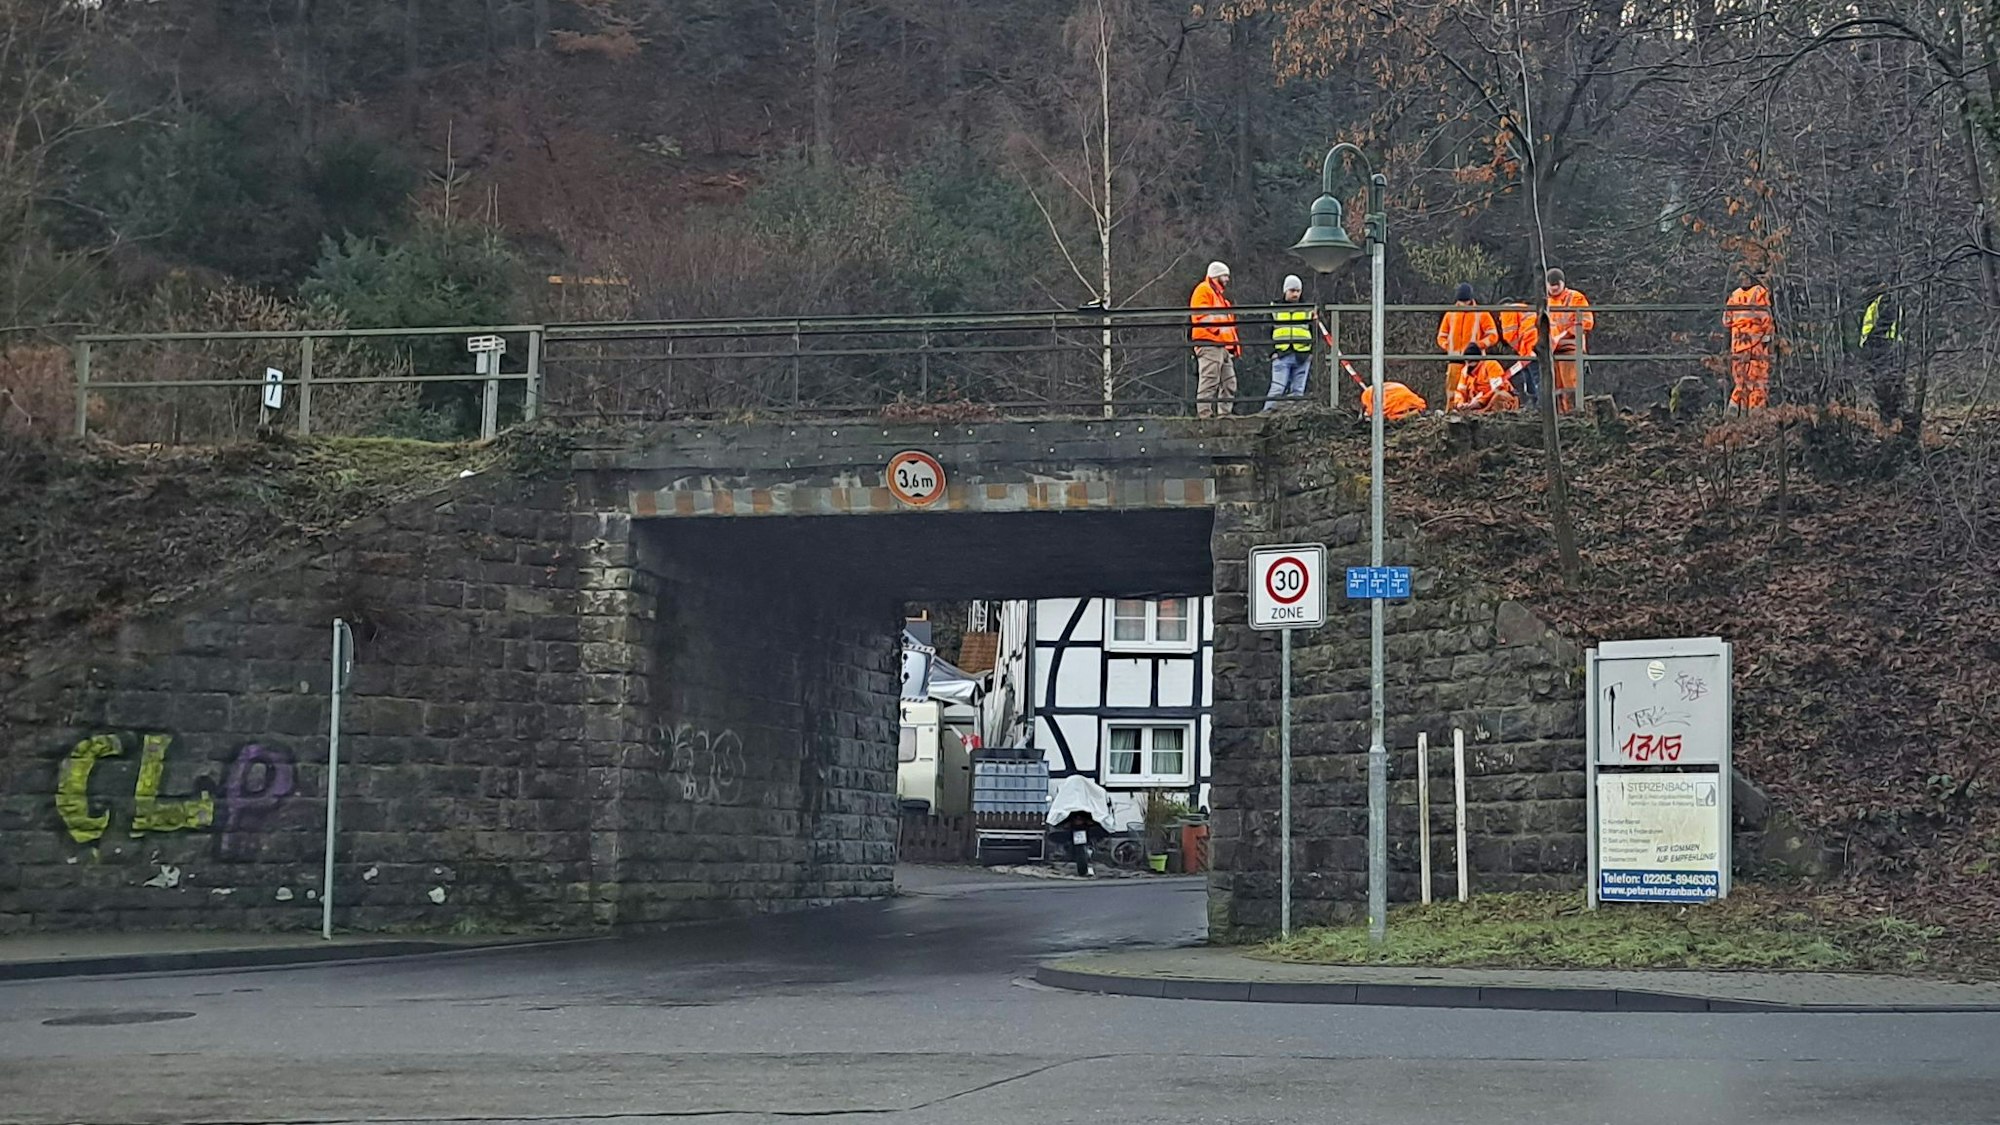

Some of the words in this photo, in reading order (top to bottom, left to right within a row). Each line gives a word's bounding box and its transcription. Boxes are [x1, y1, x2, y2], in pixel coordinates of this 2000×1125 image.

[1274, 569, 1300, 591] 30
[1271, 606, 1304, 619] ZONE
[1621, 732, 1682, 761] 1315
[1627, 781, 1694, 792] STERZENBACH
[1603, 872, 1641, 884] Telefon:
[1642, 873, 1717, 885] 02205-8946363
[1603, 886, 1717, 897] www.petersterzenbach.de
